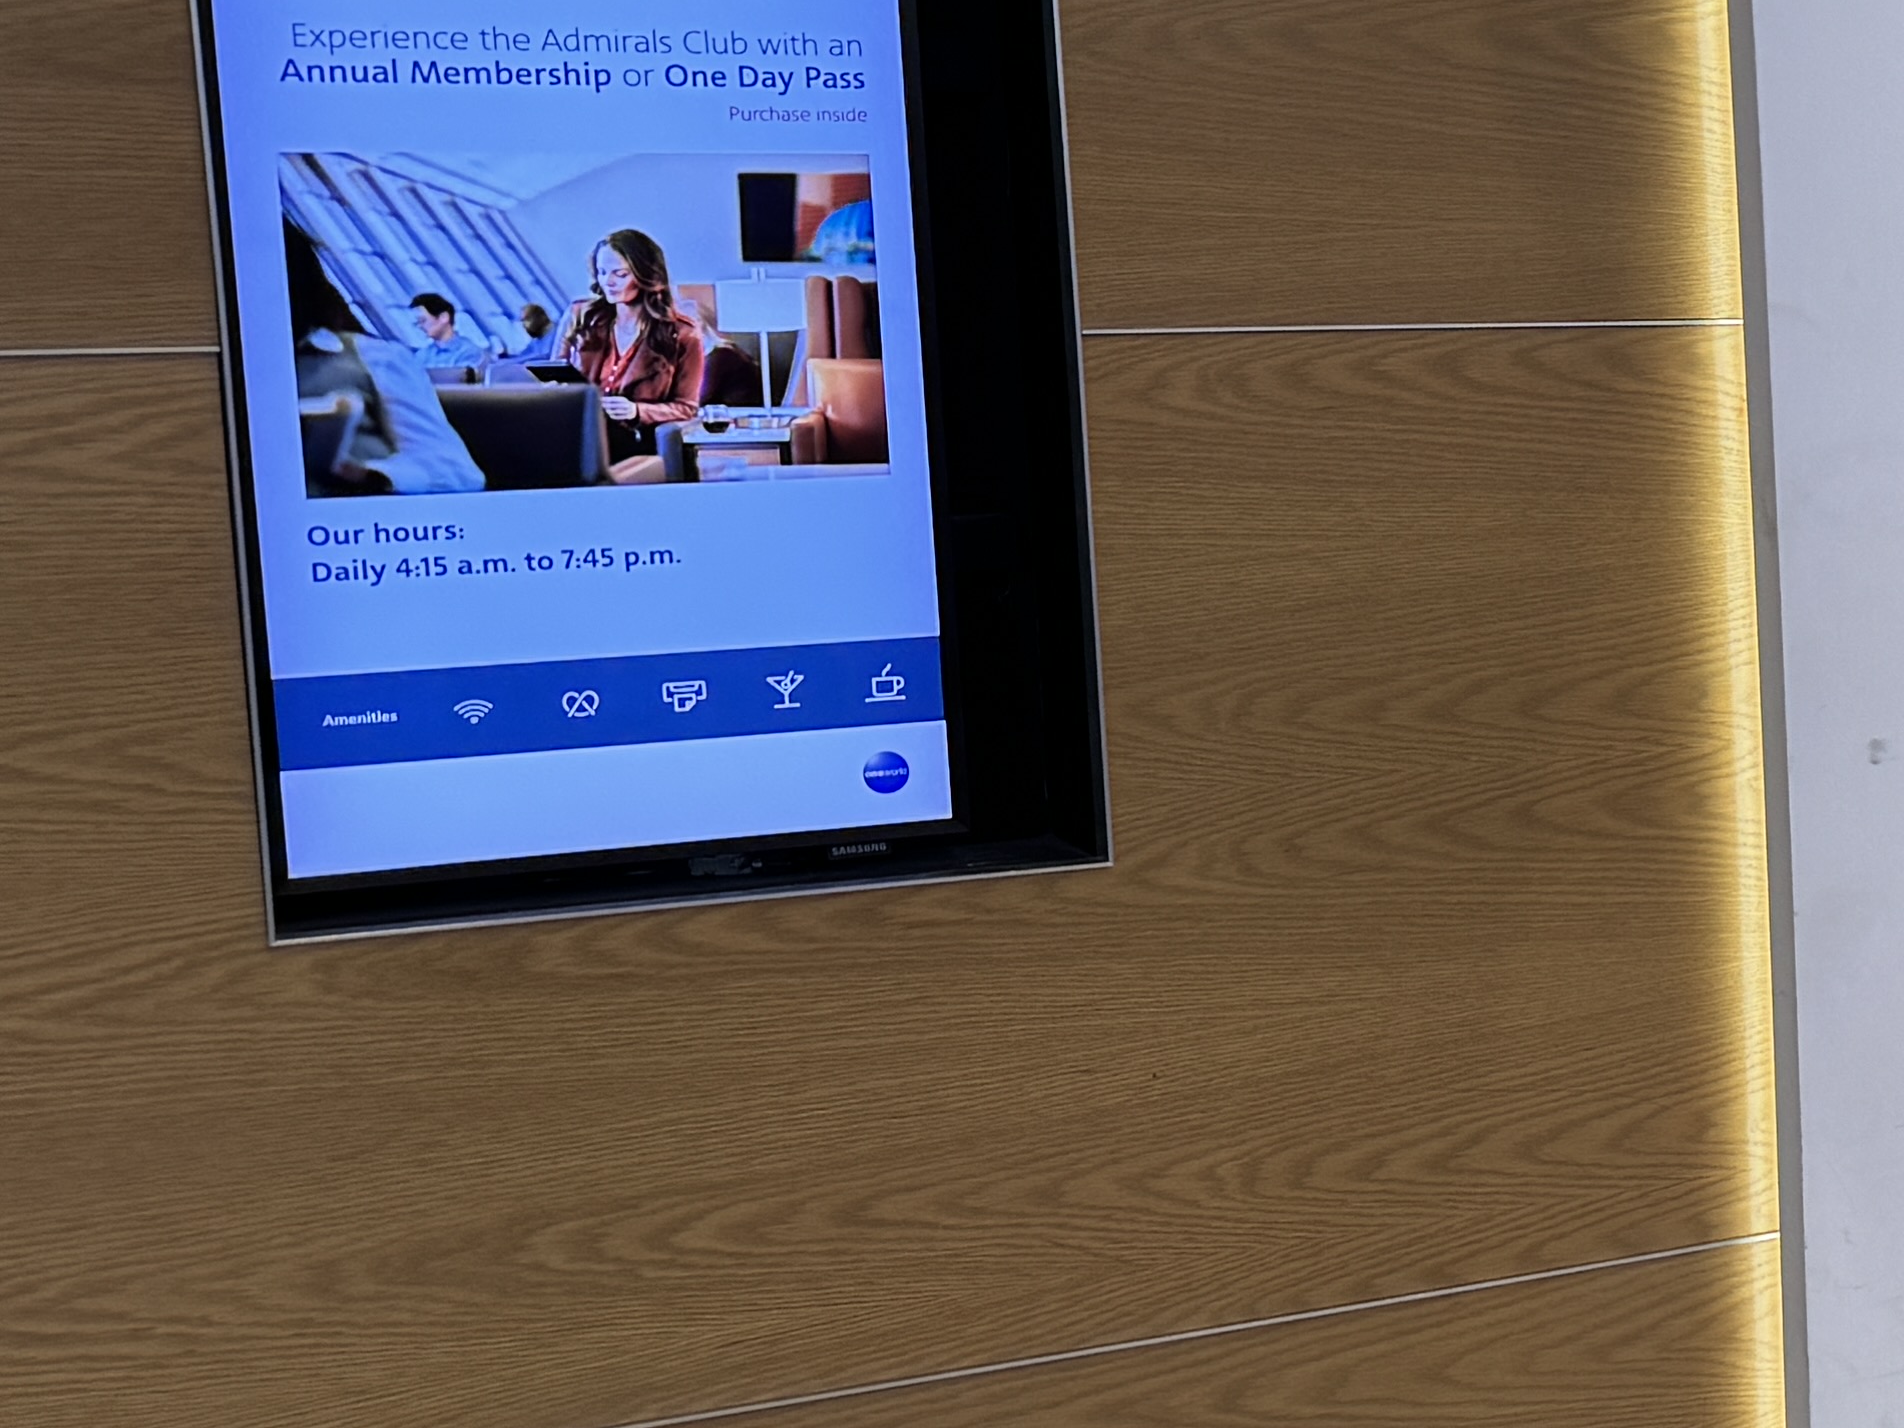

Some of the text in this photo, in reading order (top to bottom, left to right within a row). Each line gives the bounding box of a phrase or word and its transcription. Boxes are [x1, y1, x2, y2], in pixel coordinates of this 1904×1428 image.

[291, 22, 863, 57] Experience the Admirals Club with an
[279, 58, 866, 96] Annual Membership or One Day Pass
[729, 105, 868, 123] Purchase inside
[307, 521, 465, 547] Our hours:
[311, 547, 682, 587] Daily 4:15 a.m. to 7:45 p.m.
[322, 710, 398, 727] Amenities
